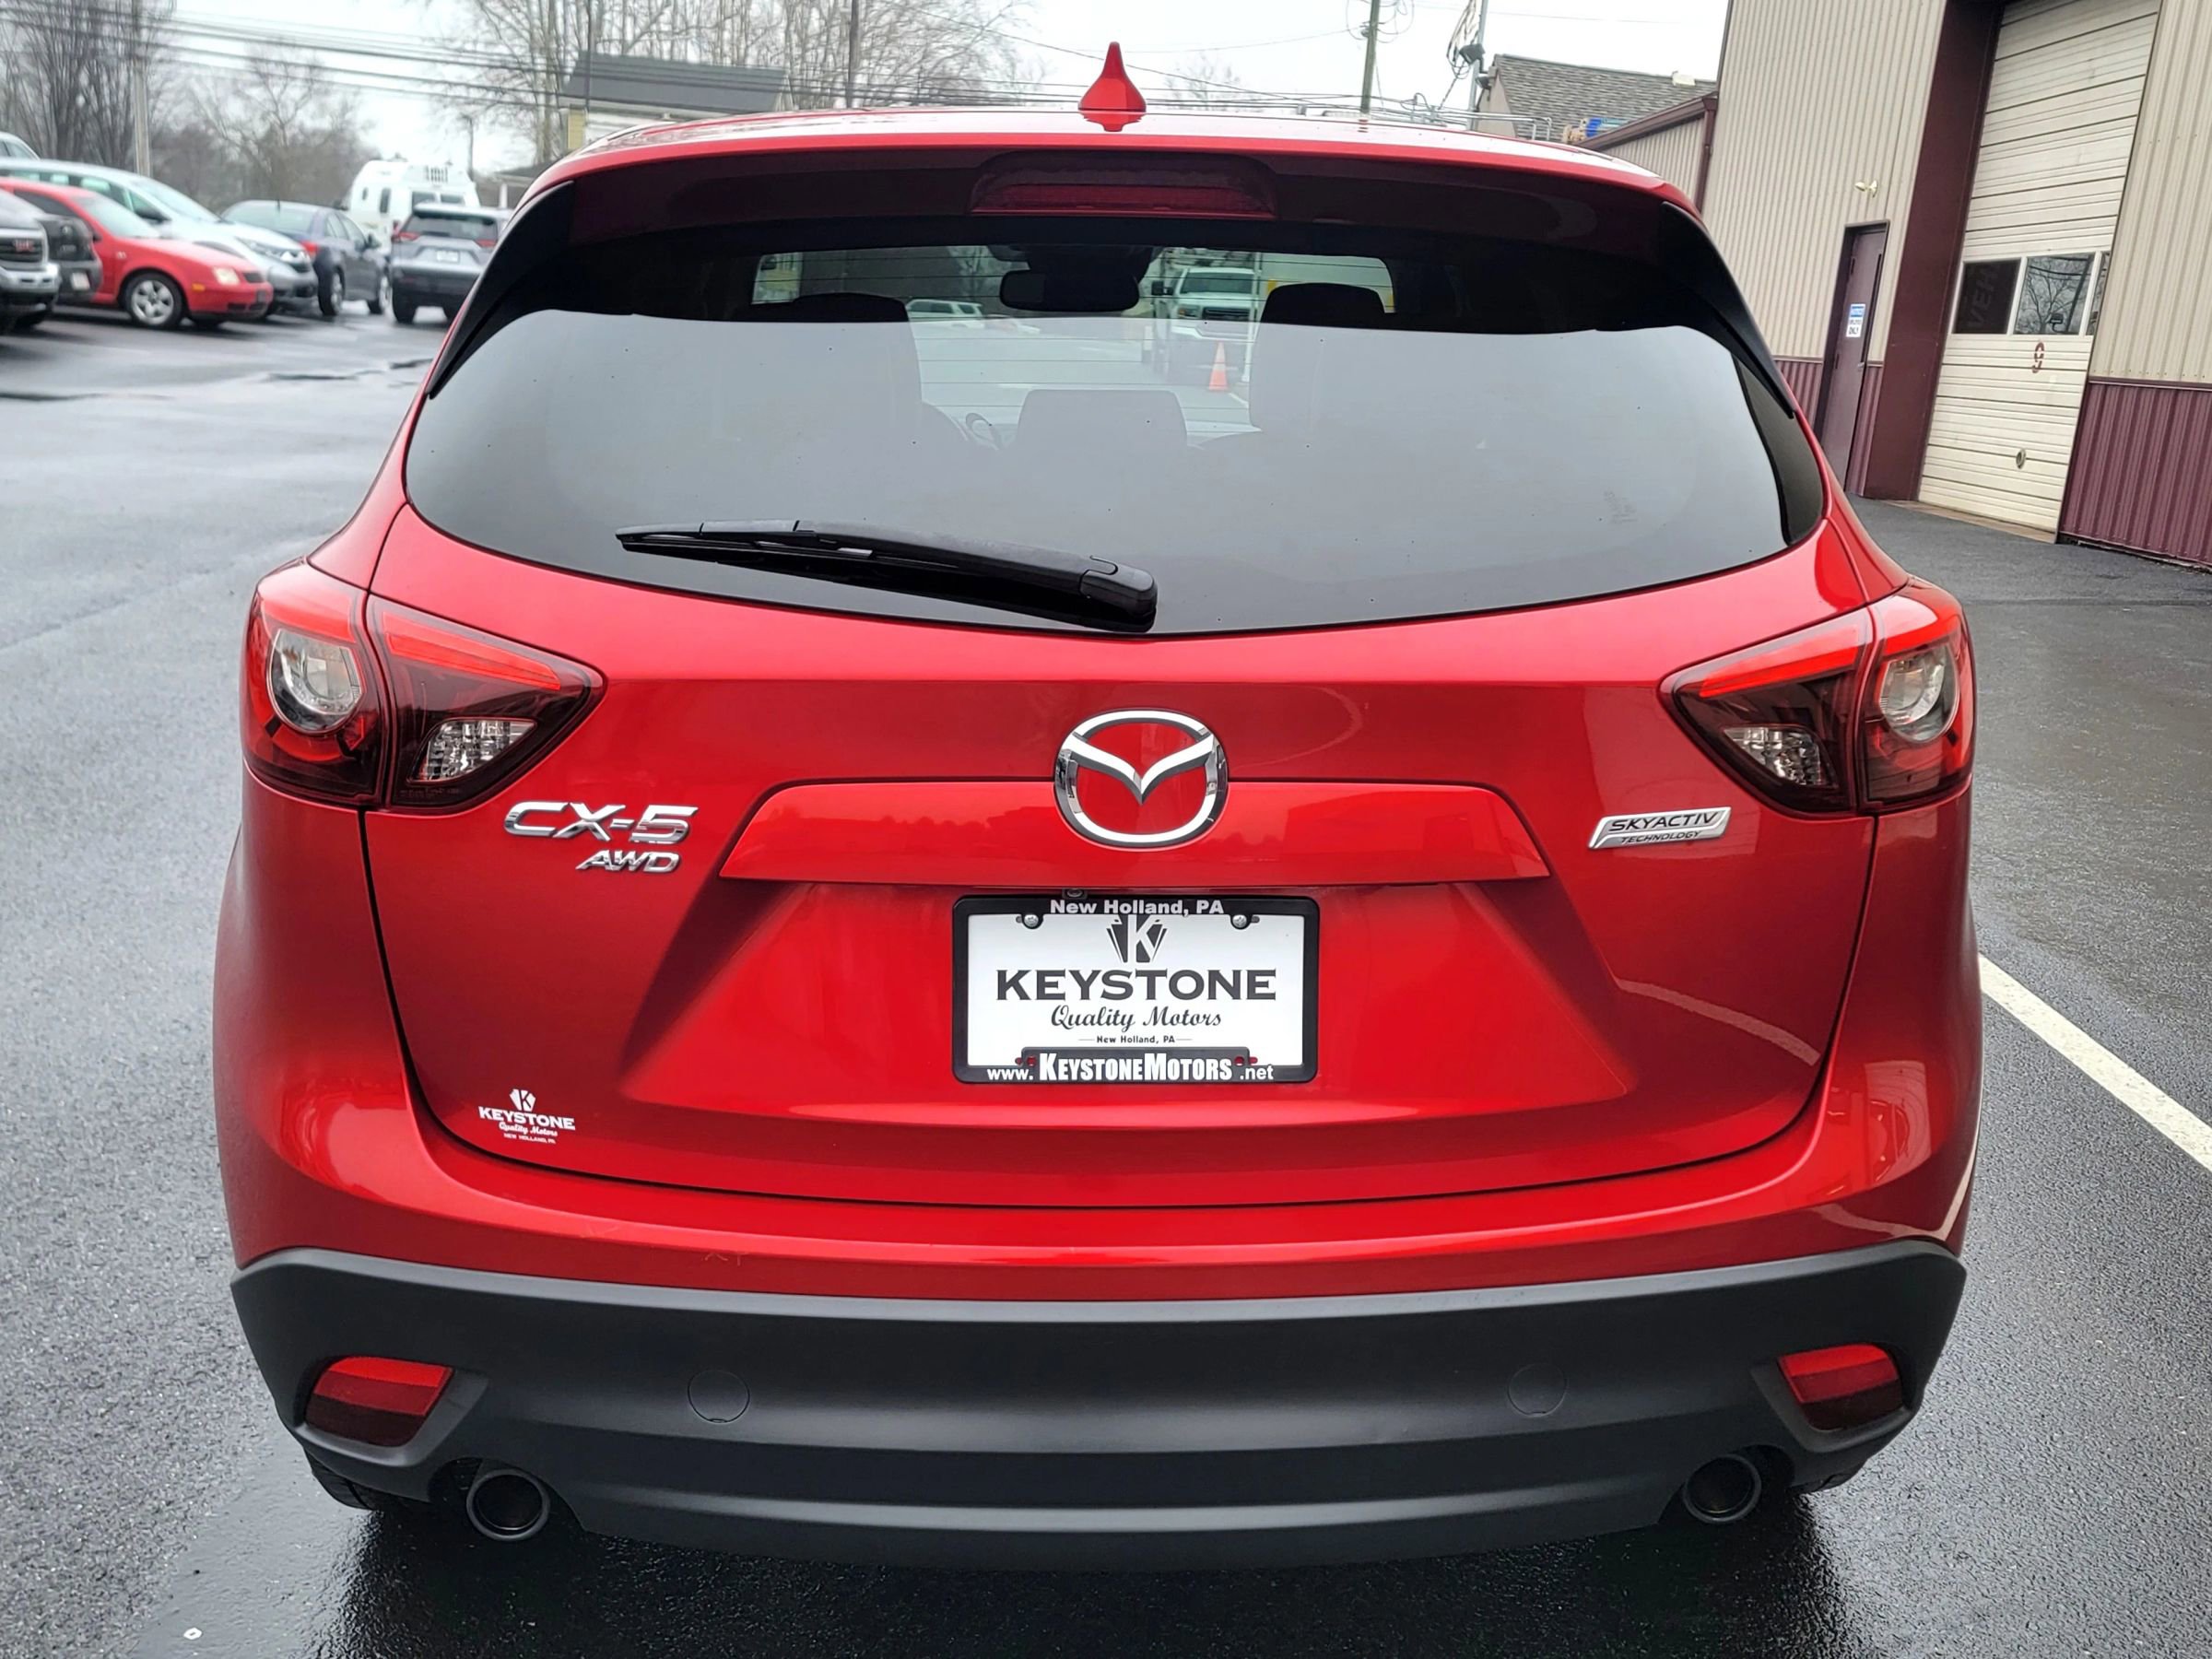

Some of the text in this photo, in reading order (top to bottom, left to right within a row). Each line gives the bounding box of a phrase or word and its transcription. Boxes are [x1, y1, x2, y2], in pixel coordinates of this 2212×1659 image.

[2031, 341, 2045, 373] 9
[504, 801, 699, 845] CX-5
[1609, 811, 1719, 832] SKYACTIV
[1620, 830, 1703, 844] TECHNOLOGY
[574, 849, 681, 873] AWD
[1050, 900, 1225, 917] New Holland, PA
[996, 969, 1277, 1001] KEYSTONE
[1051, 1004, 1222, 1033] Quality Motors
[1097, 1035, 1176, 1044] New Holland, PA
[986, 1067, 1034, 1080] www.
[1239, 1065, 1275, 1080] .net
[478, 1106, 576, 1131] KEYSTONE
[499, 1122, 529, 1135] Quality
